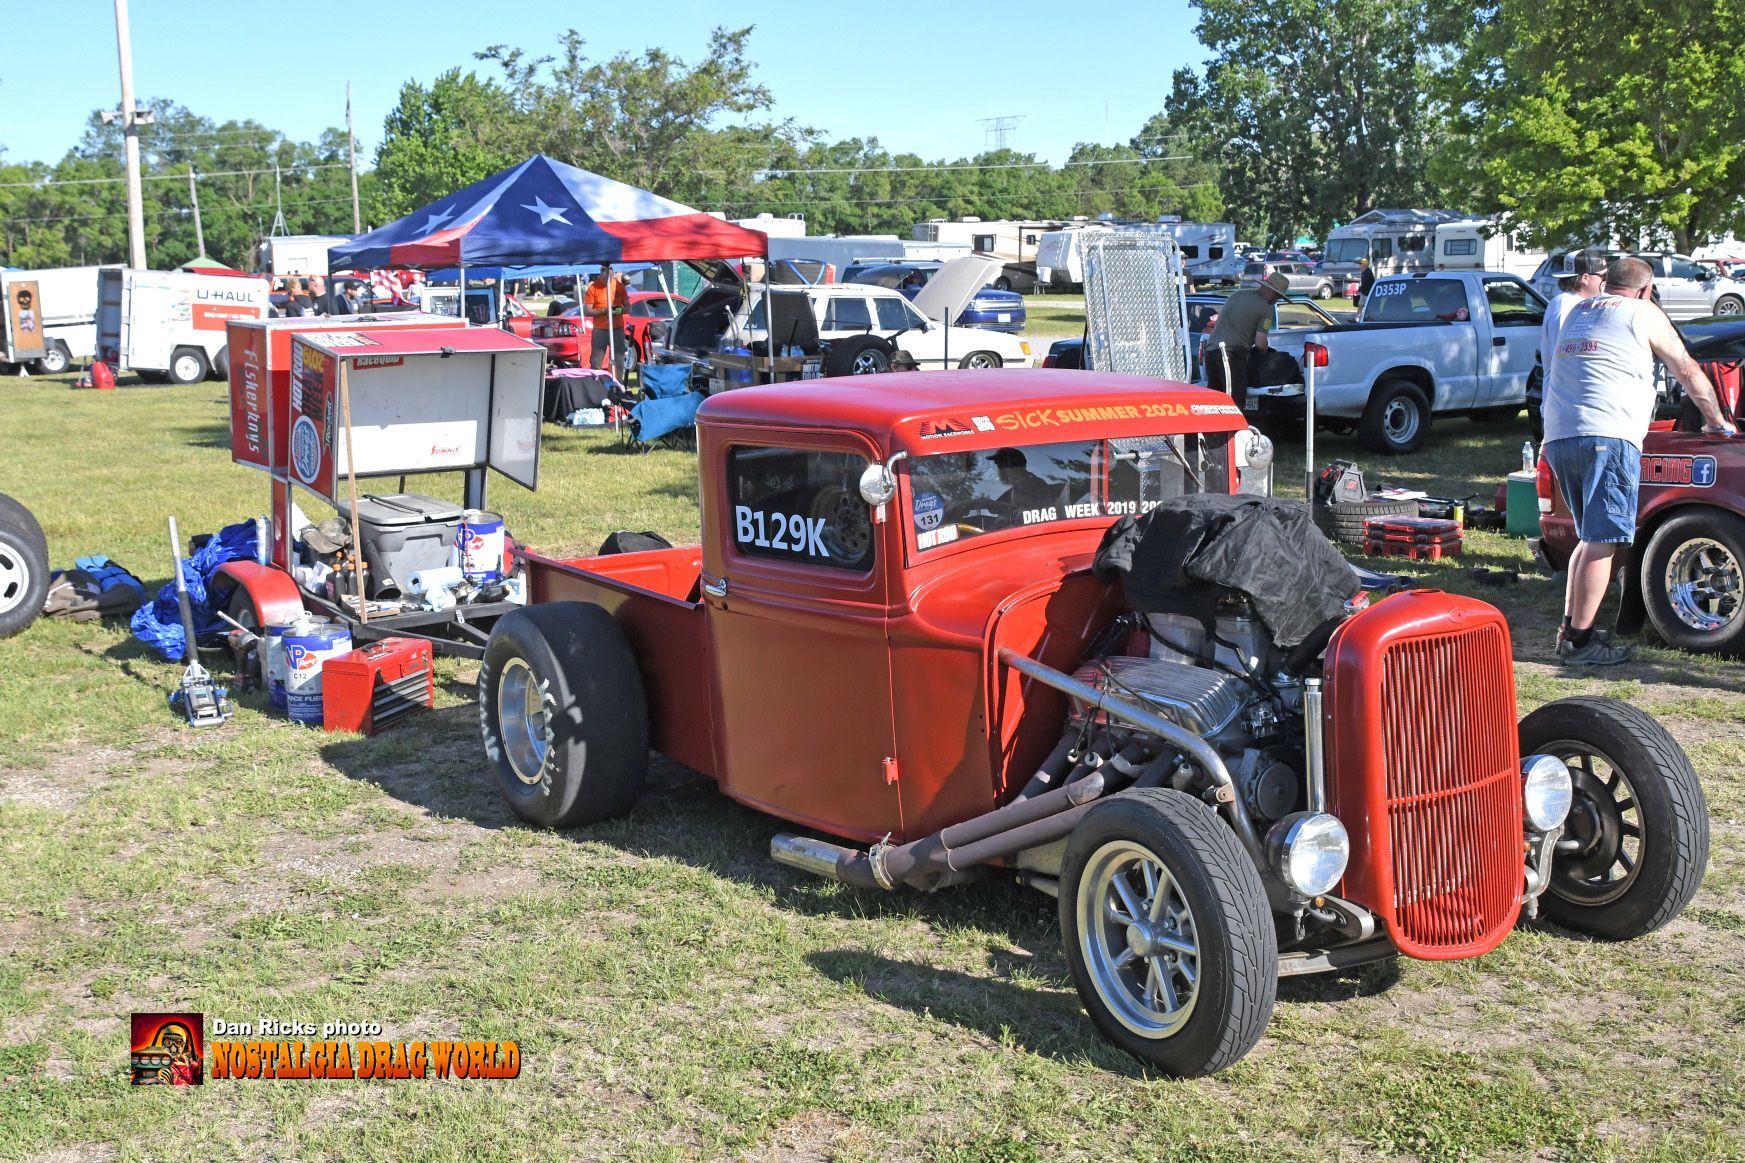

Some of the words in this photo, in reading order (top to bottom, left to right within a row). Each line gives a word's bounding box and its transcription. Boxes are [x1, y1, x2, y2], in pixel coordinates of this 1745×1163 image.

[1375, 283, 1406, 297] D353P
[1056, 405, 1142, 423] SUMMER
[1140, 403, 1189, 417] 2024
[1640, 457, 1692, 483] ACING
[920, 513, 939, 526] 131
[1022, 507, 1057, 525] DRAG
[1065, 503, 1100, 518] WEEK
[1107, 501, 1136, 515] 2019
[1141, 500, 1162, 514] 20
[735, 505, 830, 557] B129K
[917, 529, 937, 550] HOT
[285, 644, 306, 670] VP
